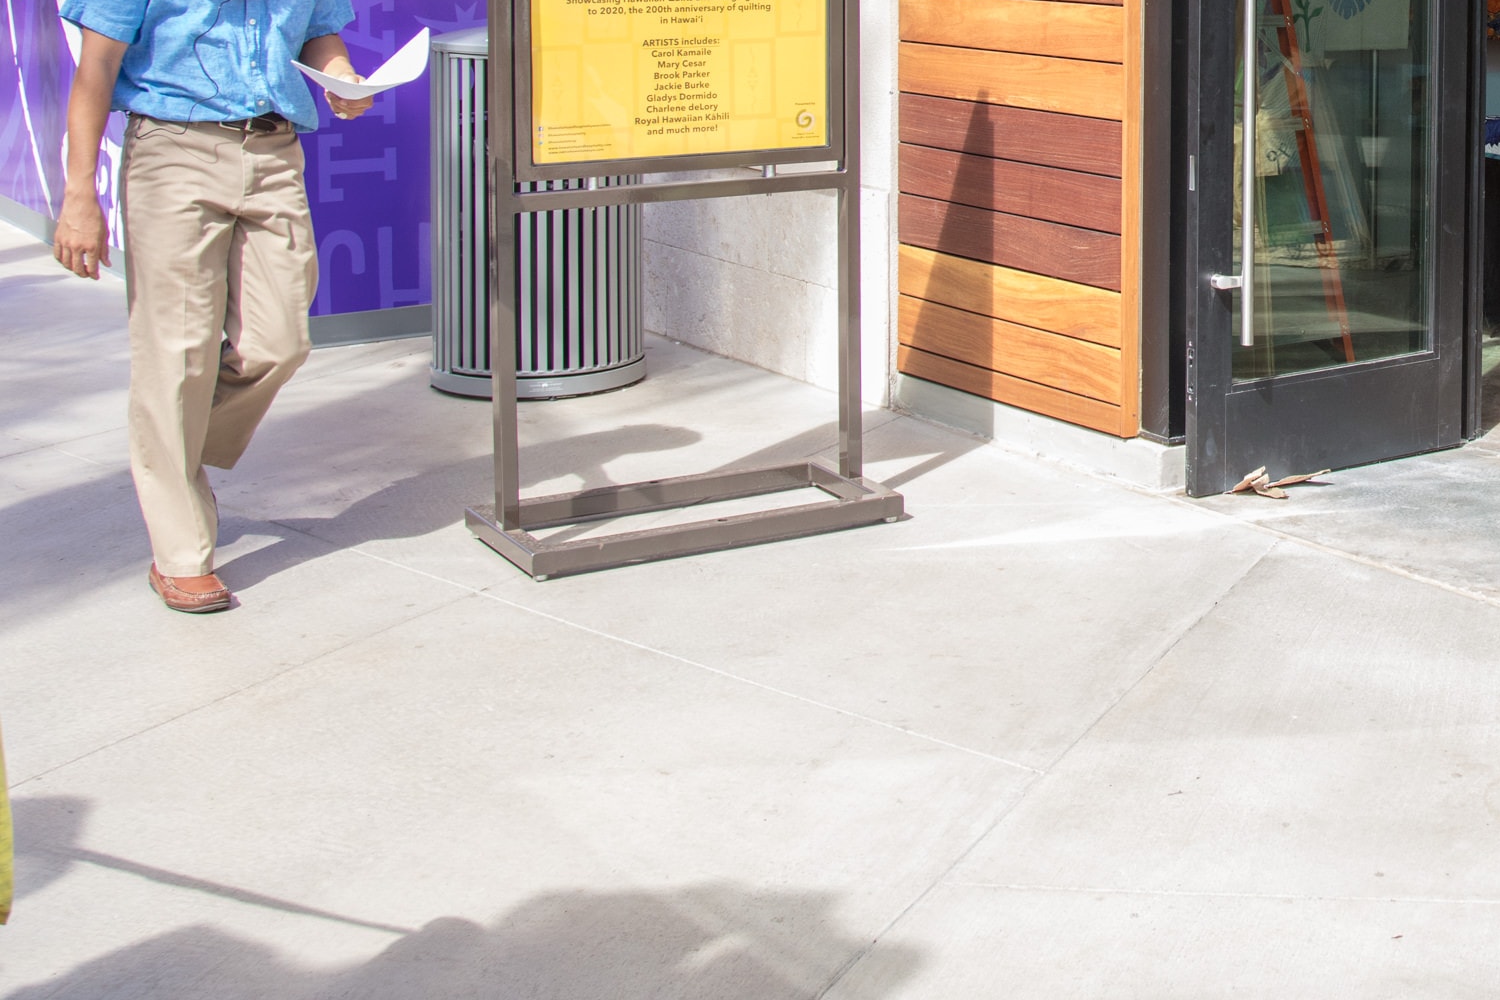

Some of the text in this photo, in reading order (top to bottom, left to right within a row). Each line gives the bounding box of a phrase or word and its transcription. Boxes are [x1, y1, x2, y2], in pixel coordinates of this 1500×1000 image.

[588, 3, 771, 16] to 2020, the 200th anniversary of quilting
[643, 37, 720, 47] ARTISTS includes:
[652, 48, 712, 58] Carol Kamaile
[657, 60, 706, 70] Mary Cesar
[654, 70, 710, 80] Brook Parker
[654, 81, 710, 91] Jackie Burke
[647, 92, 718, 103] Gladys Dormido
[646, 104, 686, 113] Charlene
[635, 114, 703, 126] Royal Hawaiian
[647, 124, 718, 136] and much more!
